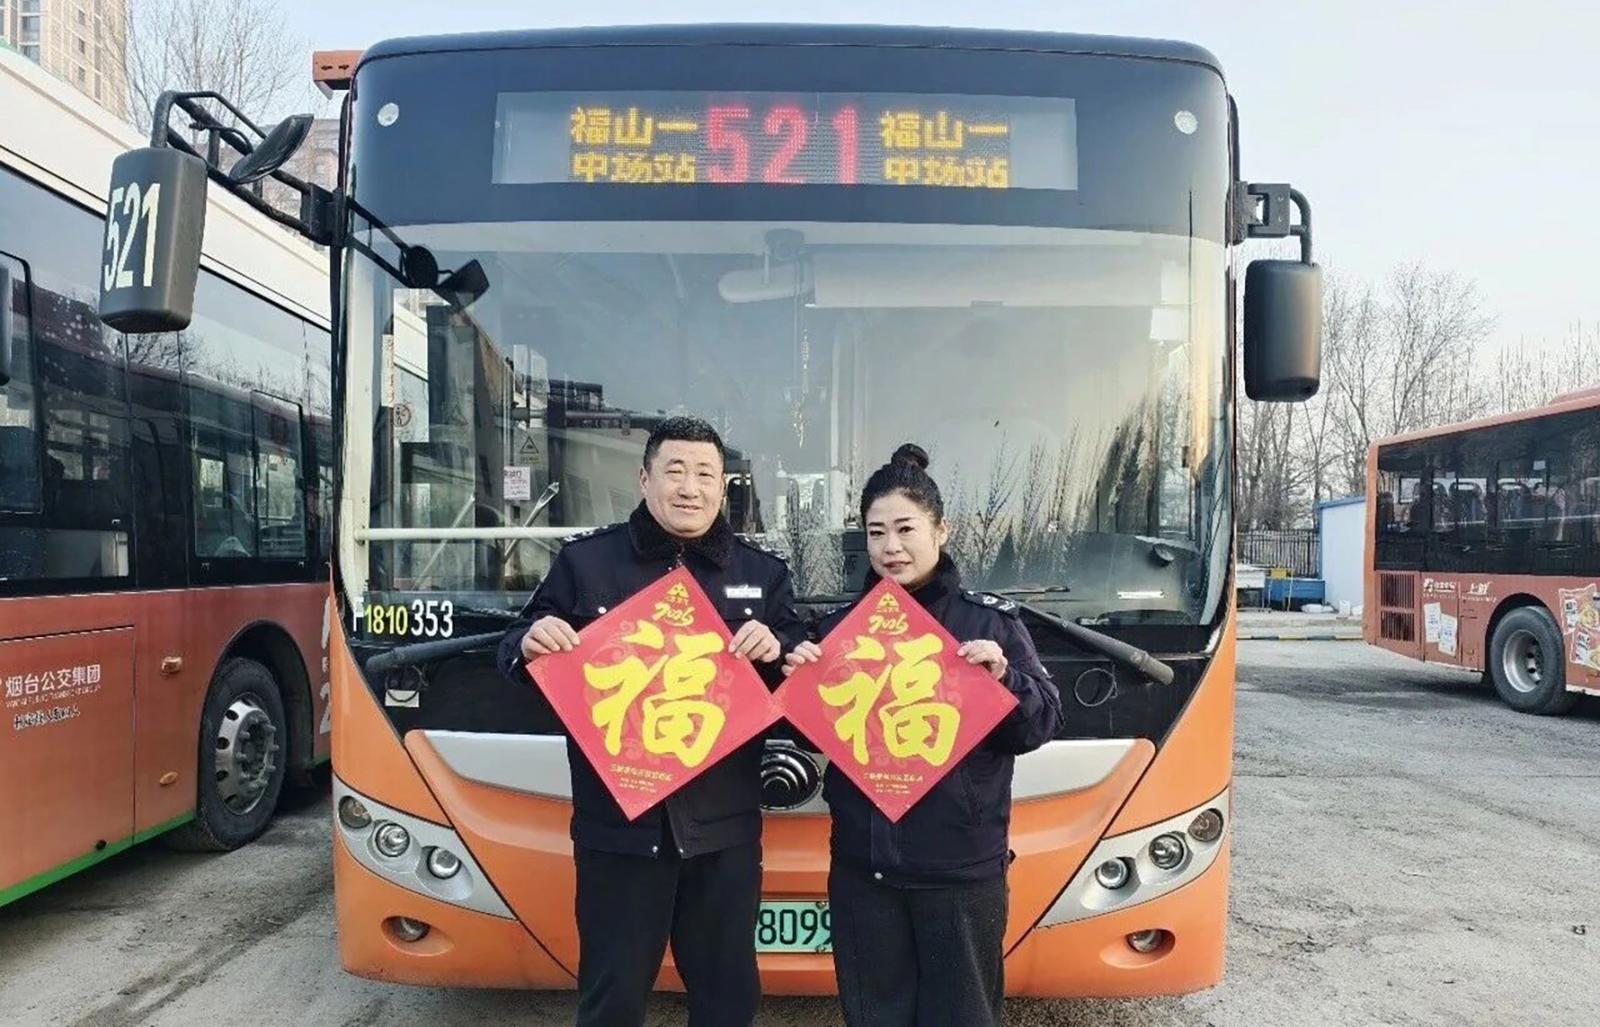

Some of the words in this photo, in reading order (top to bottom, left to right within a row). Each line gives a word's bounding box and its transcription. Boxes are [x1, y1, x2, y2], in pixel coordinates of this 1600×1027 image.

[708, 106, 857, 185] 521
[104, 181, 161, 292] 521
[5, 664, 101, 698] 烟台公交集团
[583, 620, 725, 769] 福
[818, 632, 962, 766] 福
